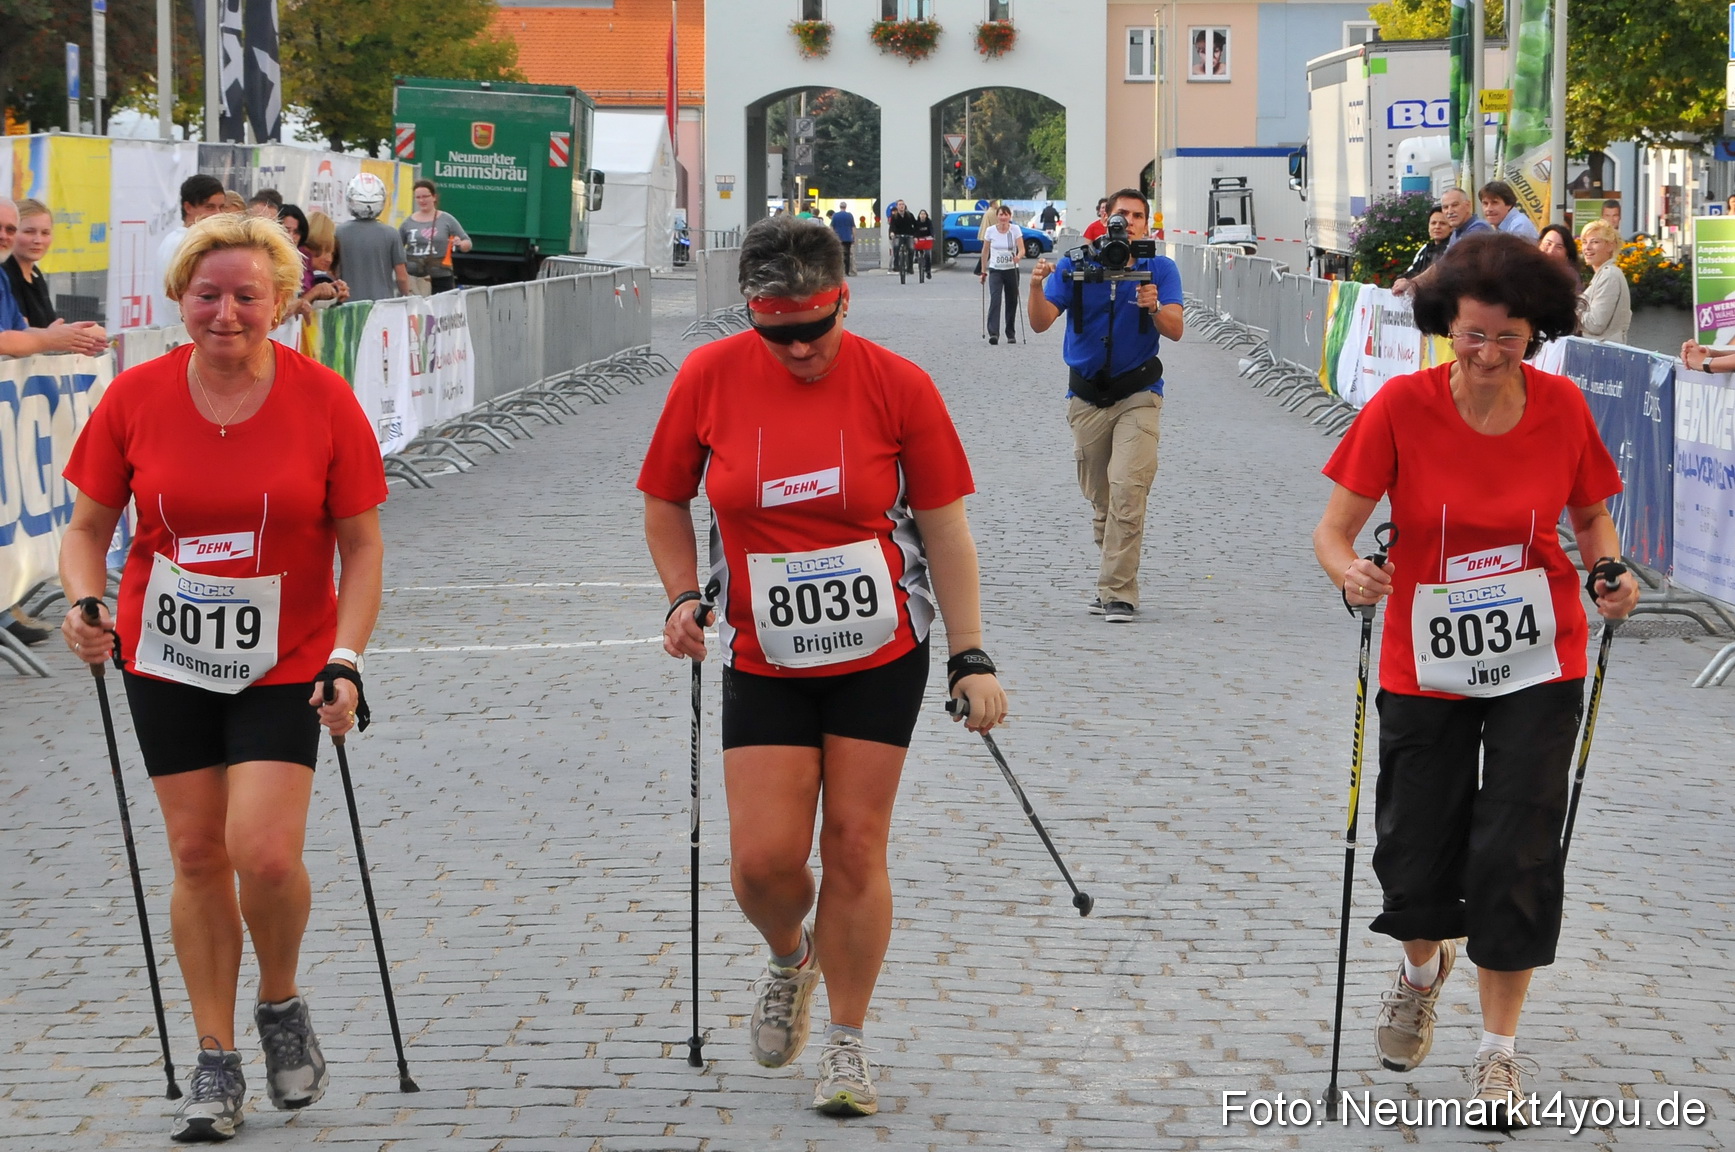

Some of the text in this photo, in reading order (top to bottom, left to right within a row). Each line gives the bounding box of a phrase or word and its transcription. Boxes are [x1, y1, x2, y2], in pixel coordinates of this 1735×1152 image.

[448, 151, 516, 165] Neumarkter
[435, 161, 527, 181] Lammsbräu
[410, 229, 418, 242] I
[783, 479, 819, 497] DEHN
[196, 541, 232, 555] DEHN
[787, 555, 845, 574] BOCK
[1467, 555, 1502, 571] DEHN
[178, 577, 235, 597] BOCK
[1448, 584, 1506, 604] BOCK
[768, 575, 879, 628] 8039
[156, 593, 262, 650] 8019
[1429, 604, 1541, 659] 8034
[793, 631, 864, 655] Brigitte
[163, 643, 250, 679] Rosmarie
